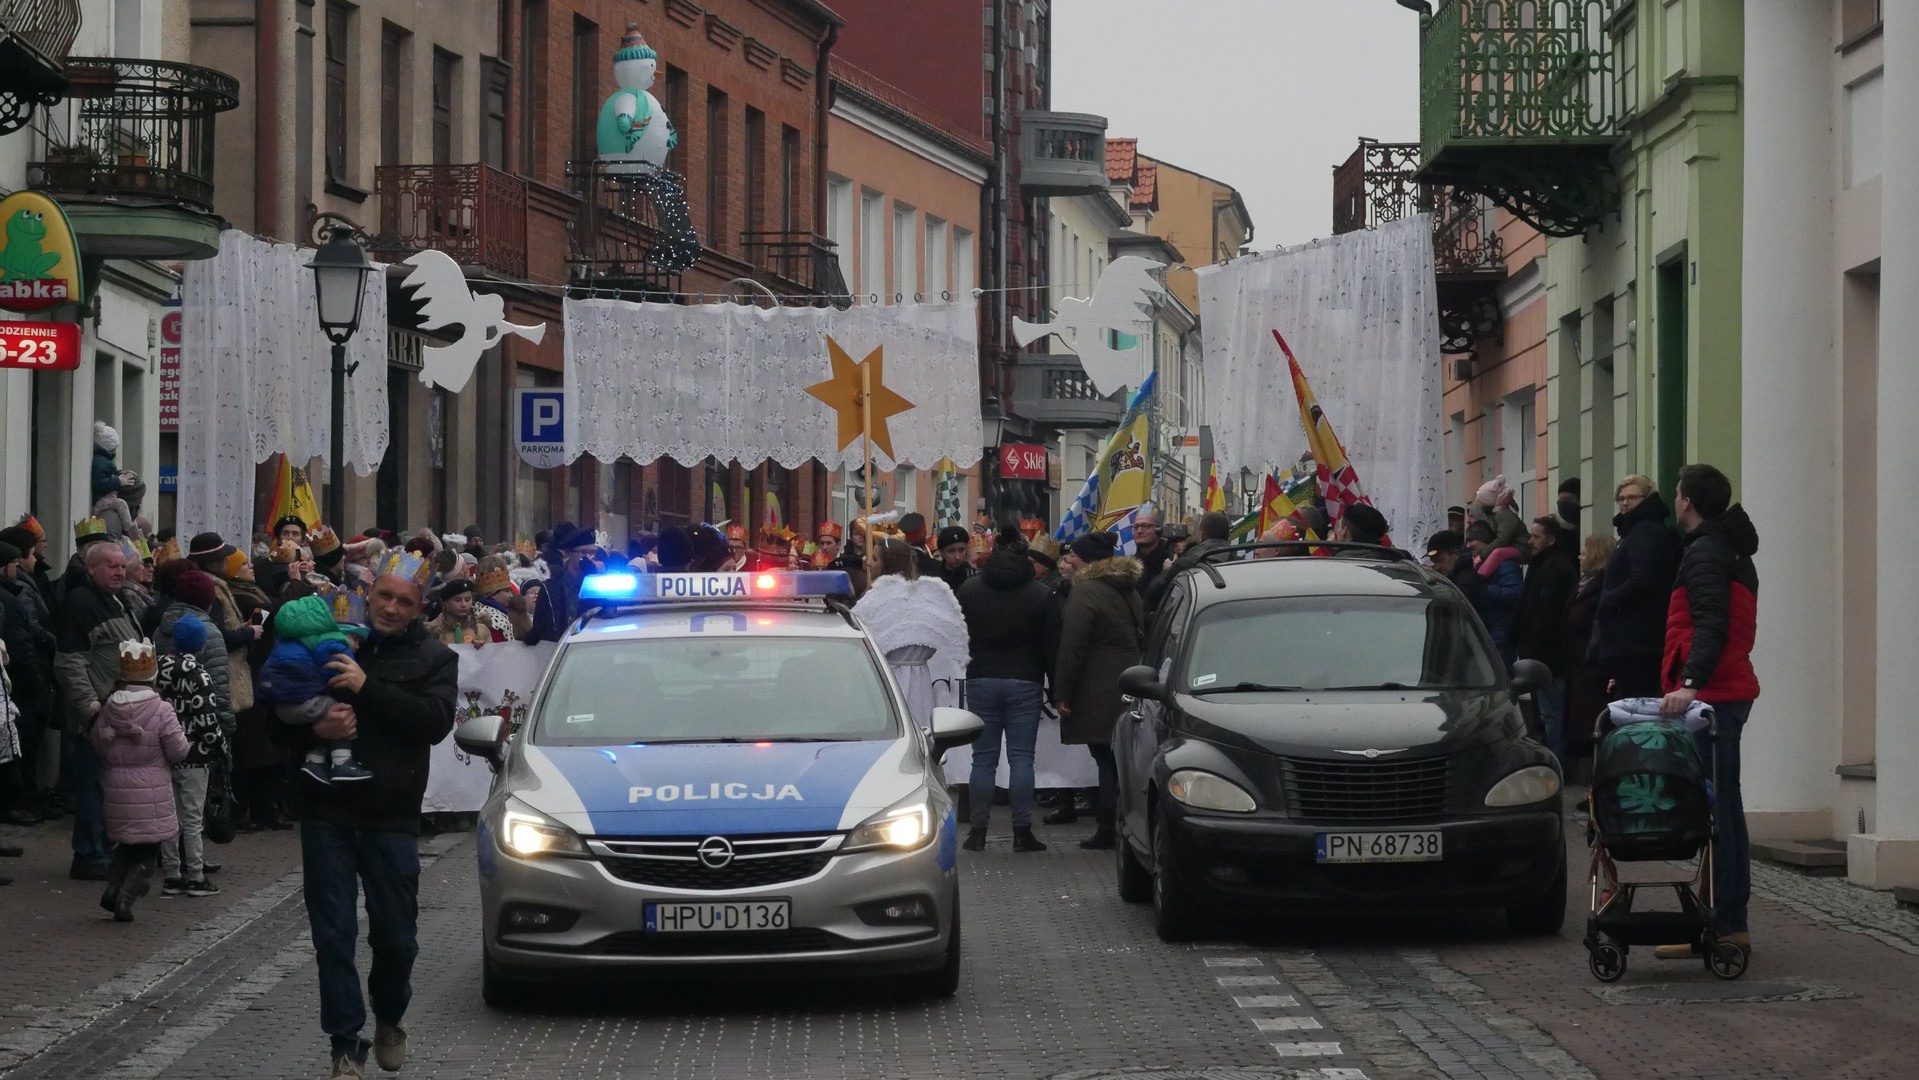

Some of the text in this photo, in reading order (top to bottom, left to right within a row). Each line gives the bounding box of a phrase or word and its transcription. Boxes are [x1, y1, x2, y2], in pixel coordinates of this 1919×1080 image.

[533, 399, 560, 436] P
[661, 577, 747, 597] POLICJA
[628, 783, 804, 804] POLICJA
[1330, 833, 1439, 857] PN 68738
[660, 904, 785, 930] HPU D136
